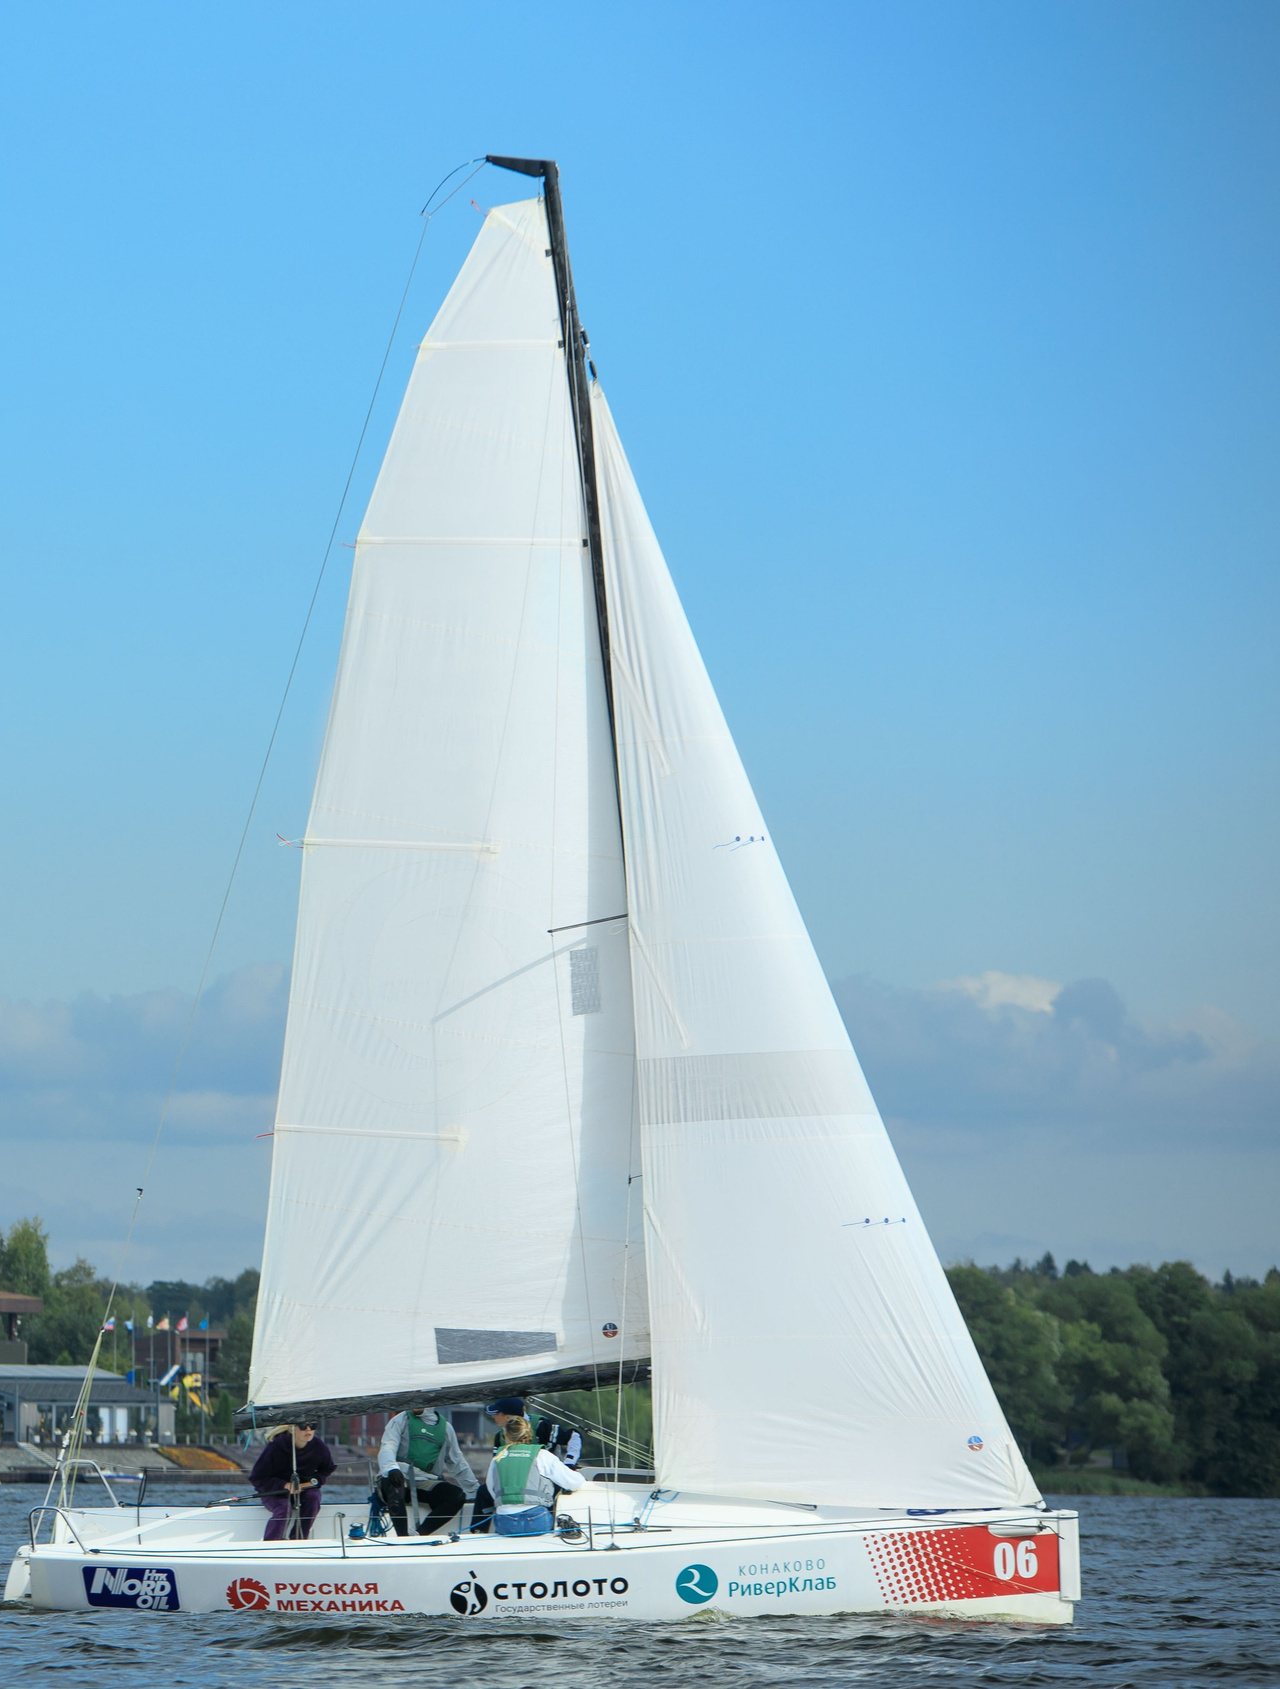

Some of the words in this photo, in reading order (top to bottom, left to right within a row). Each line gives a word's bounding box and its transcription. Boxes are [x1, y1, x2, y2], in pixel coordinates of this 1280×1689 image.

[738, 1558, 826, 1576] КОНАКОВО
[993, 1540, 1039, 1581] 06
[274, 1582, 379, 1595] РУССКАЯ
[493, 1577, 629, 1600] СТОЛОТО
[728, 1576, 837, 1598] РиверКлаб
[136, 1595, 170, 1610] OIL
[276, 1599, 406, 1612] МЕХАНИКА
[495, 1602, 585, 1614] Государственные
[587, 1600, 629, 1609] лотереи
